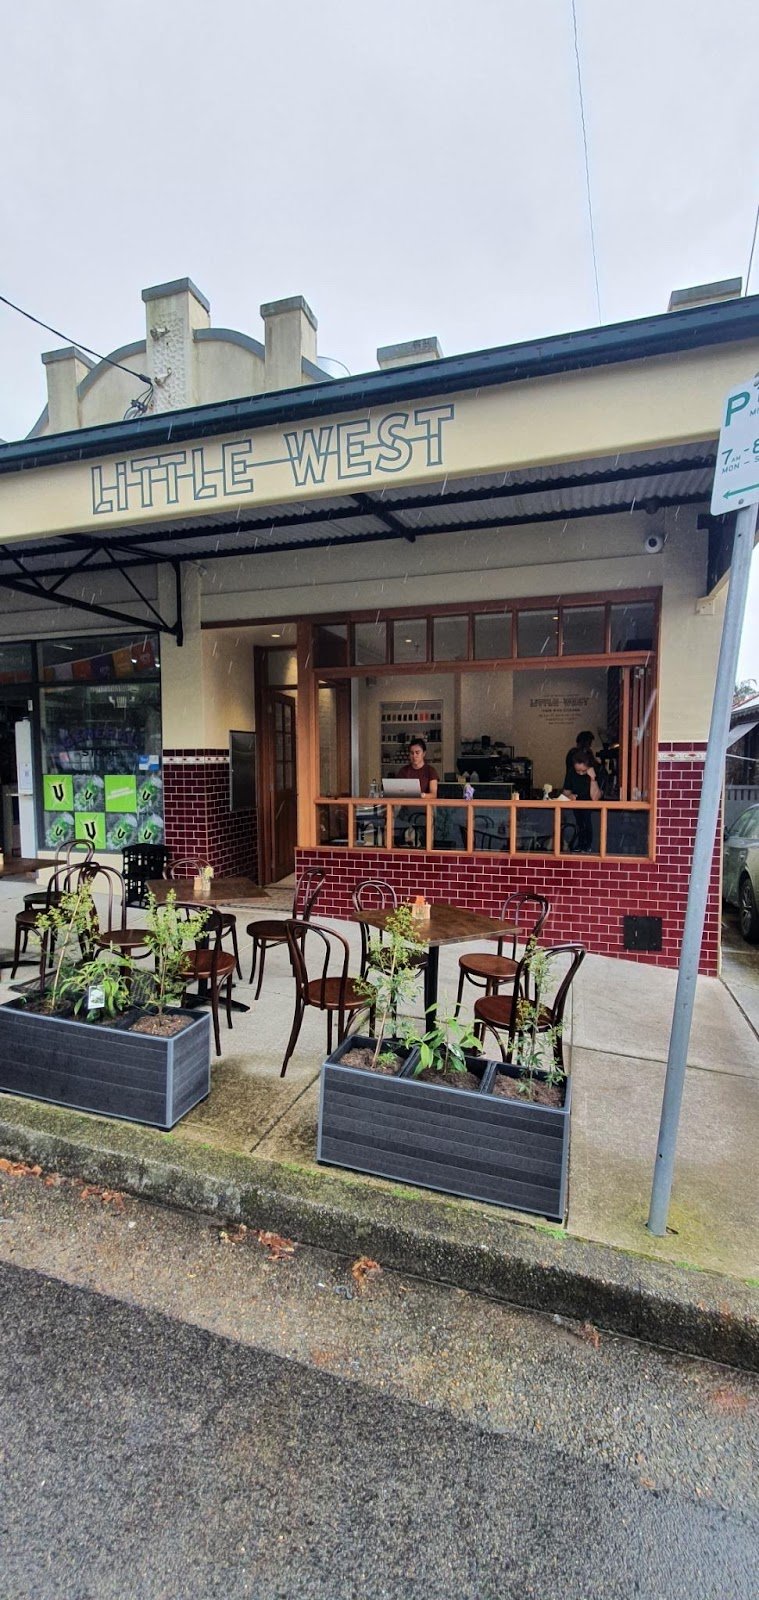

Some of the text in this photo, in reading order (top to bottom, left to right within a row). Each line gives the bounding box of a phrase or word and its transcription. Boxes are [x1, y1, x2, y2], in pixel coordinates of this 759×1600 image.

[725, 392, 750, 427] P
[283, 403, 455, 487] WEST
[721, 463, 740, 474] MON
